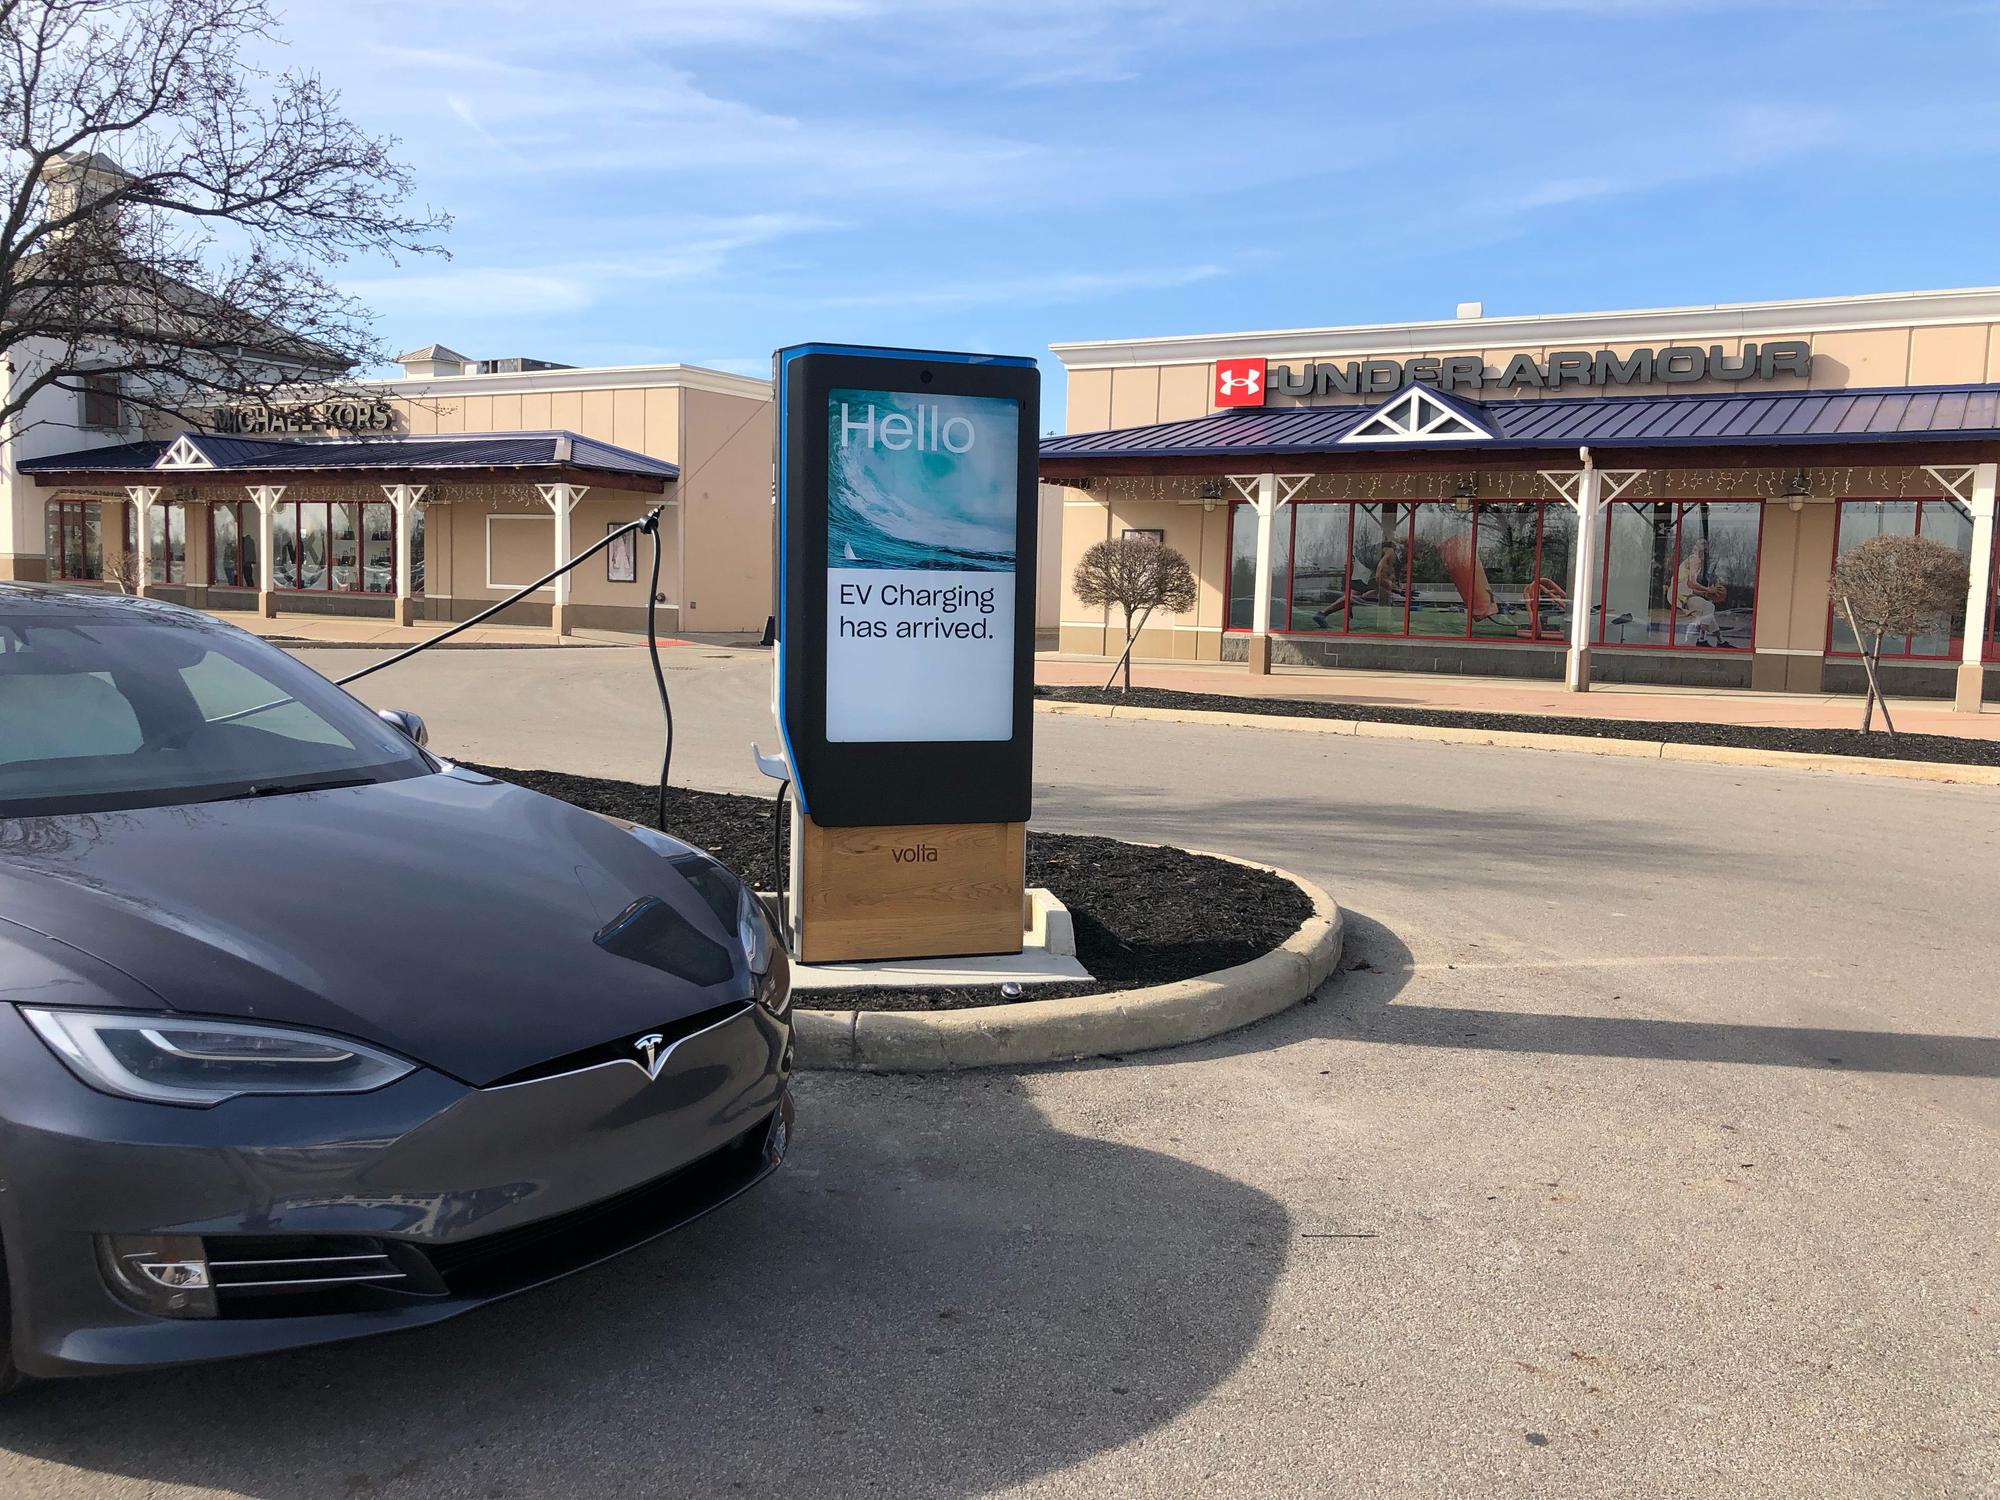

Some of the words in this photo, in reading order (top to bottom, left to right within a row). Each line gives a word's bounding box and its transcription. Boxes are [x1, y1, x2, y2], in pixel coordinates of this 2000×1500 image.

[1278, 356, 1484, 397] UNDER
[1497, 341, 1812, 388] ARMOUR
[325, 402, 392, 430] KORS
[841, 402, 976, 454] Hello
[840, 584, 872, 605] EV
[881, 584, 995, 614] Charging
[840, 616, 887, 638] has
[896, 617, 994, 639] arrived.
[891, 844, 938, 864] volta
